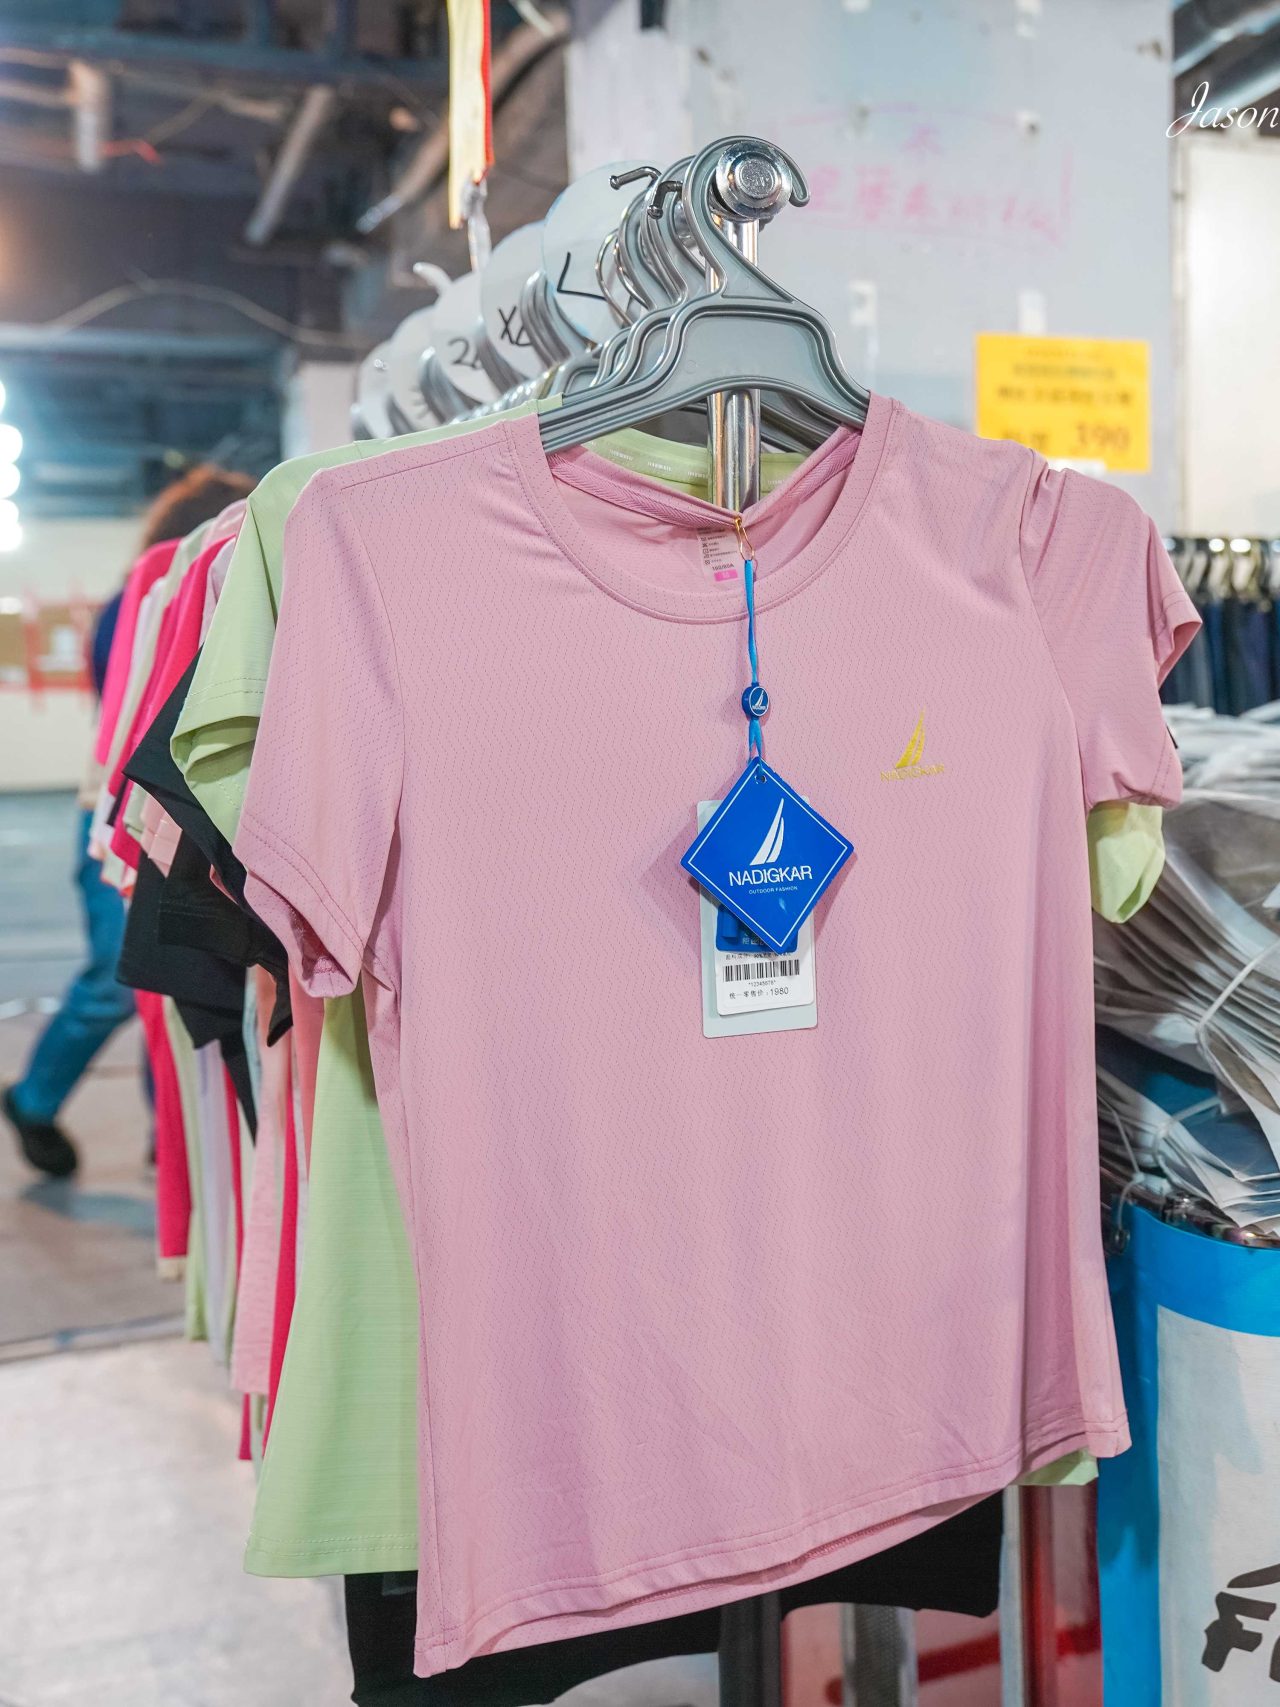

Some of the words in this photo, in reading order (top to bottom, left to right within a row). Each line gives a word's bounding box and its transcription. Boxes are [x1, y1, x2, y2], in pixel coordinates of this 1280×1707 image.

[728, 865, 813, 887] NADIGKAR
[748, 887, 775, 895] OUTDOOR
[775, 885, 798, 893] FASHION
